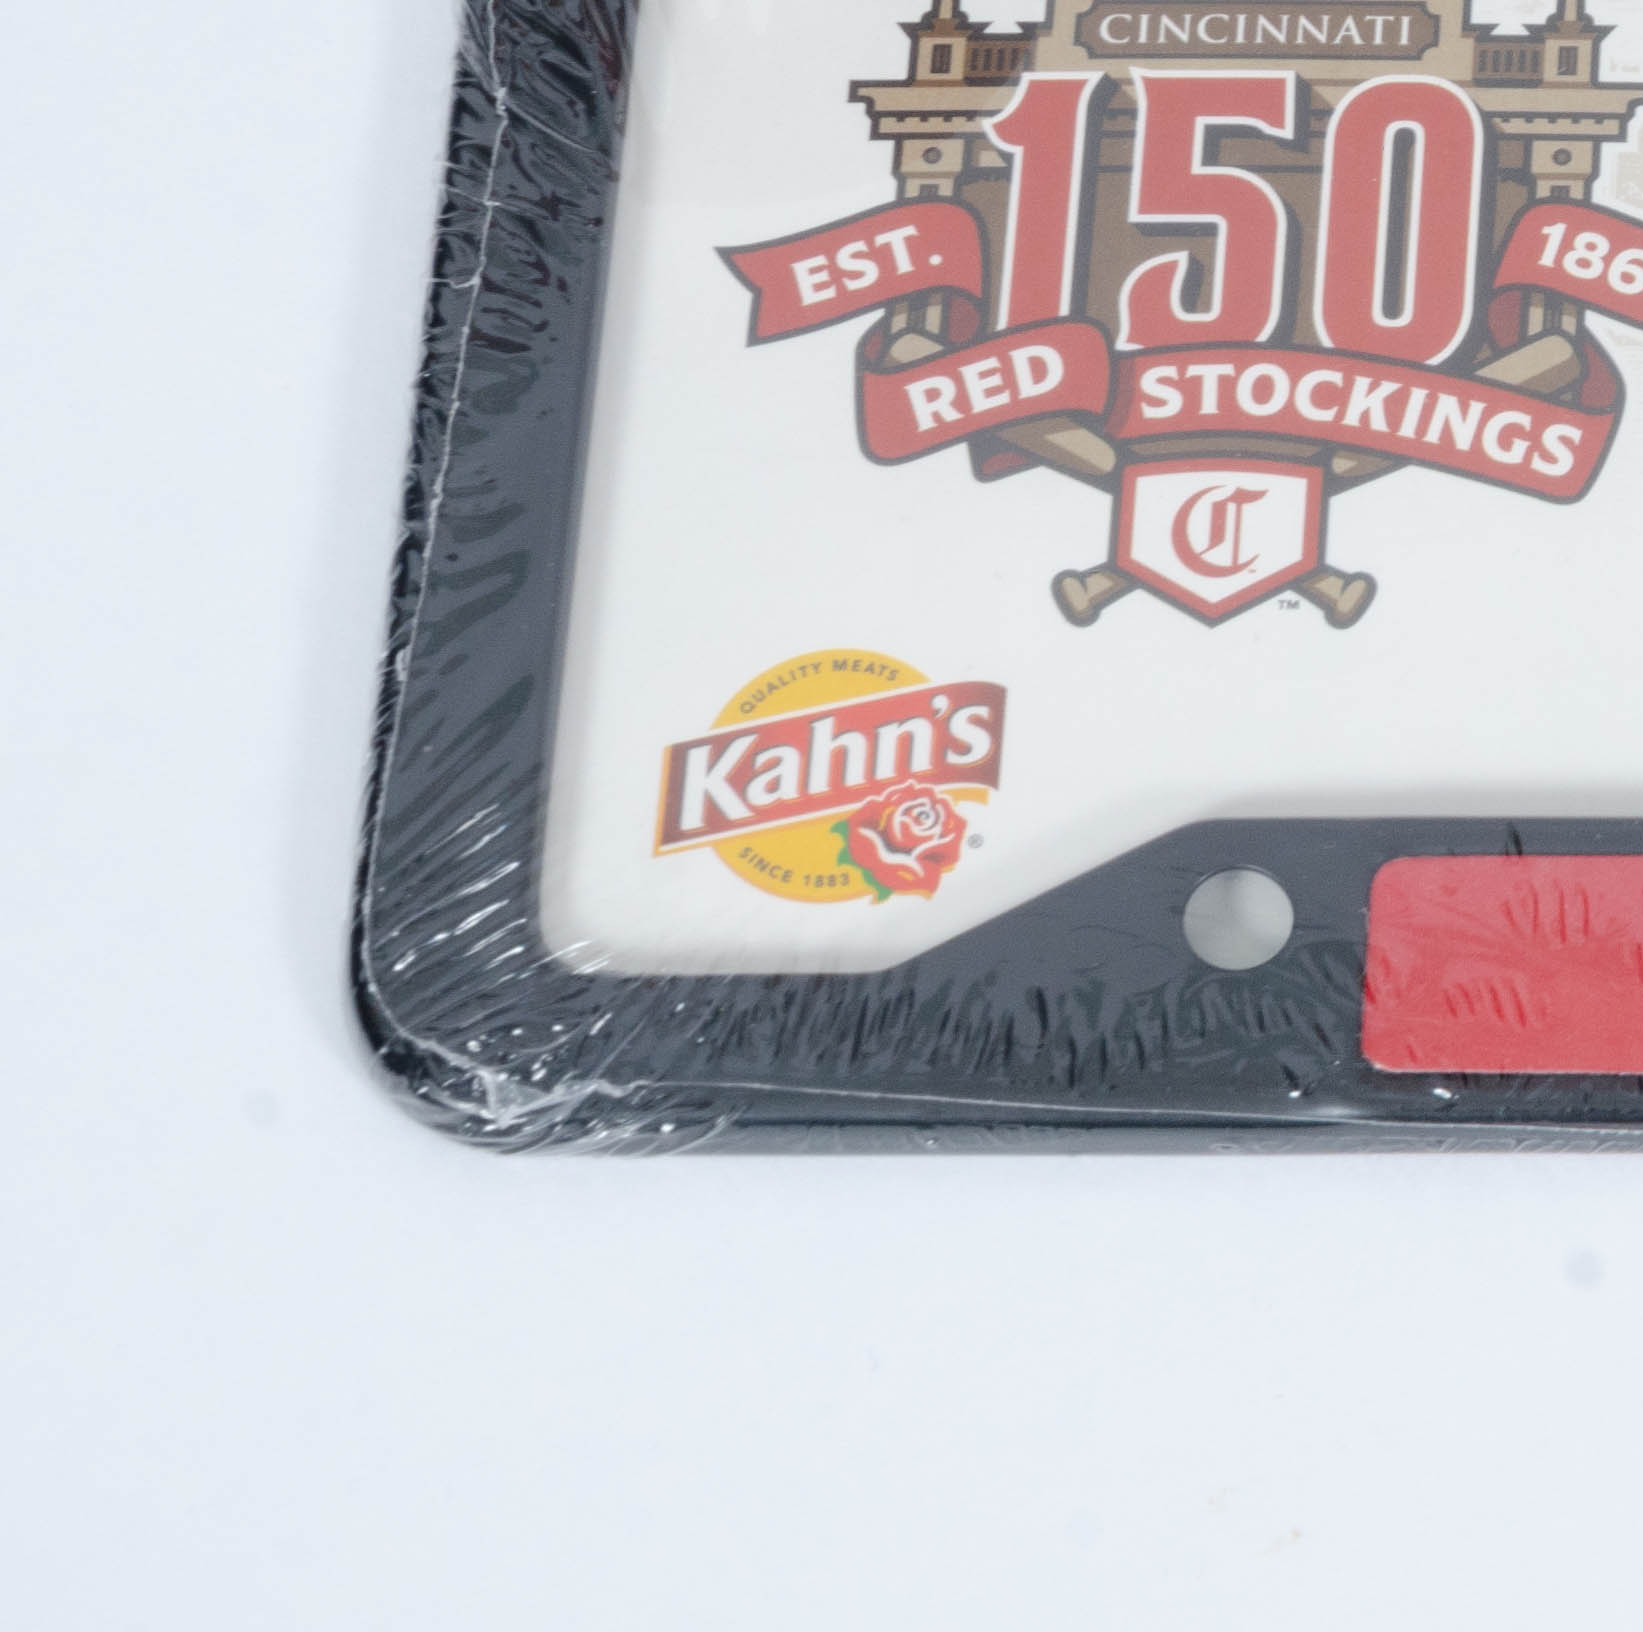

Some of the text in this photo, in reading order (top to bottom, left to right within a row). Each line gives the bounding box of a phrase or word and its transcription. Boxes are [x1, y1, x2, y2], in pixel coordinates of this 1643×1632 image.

[1098, 11, 1413, 49] CINCINNATI
[980, 67, 1485, 368] 150
[790, 221, 946, 307] EST.
[903, 342, 1584, 480] RED STOCKINGS
[740, 658, 901, 715] QUALITY MEATS
[679, 694, 992, 832] Kahn's
[737, 846, 851, 889] SINCE 1883
